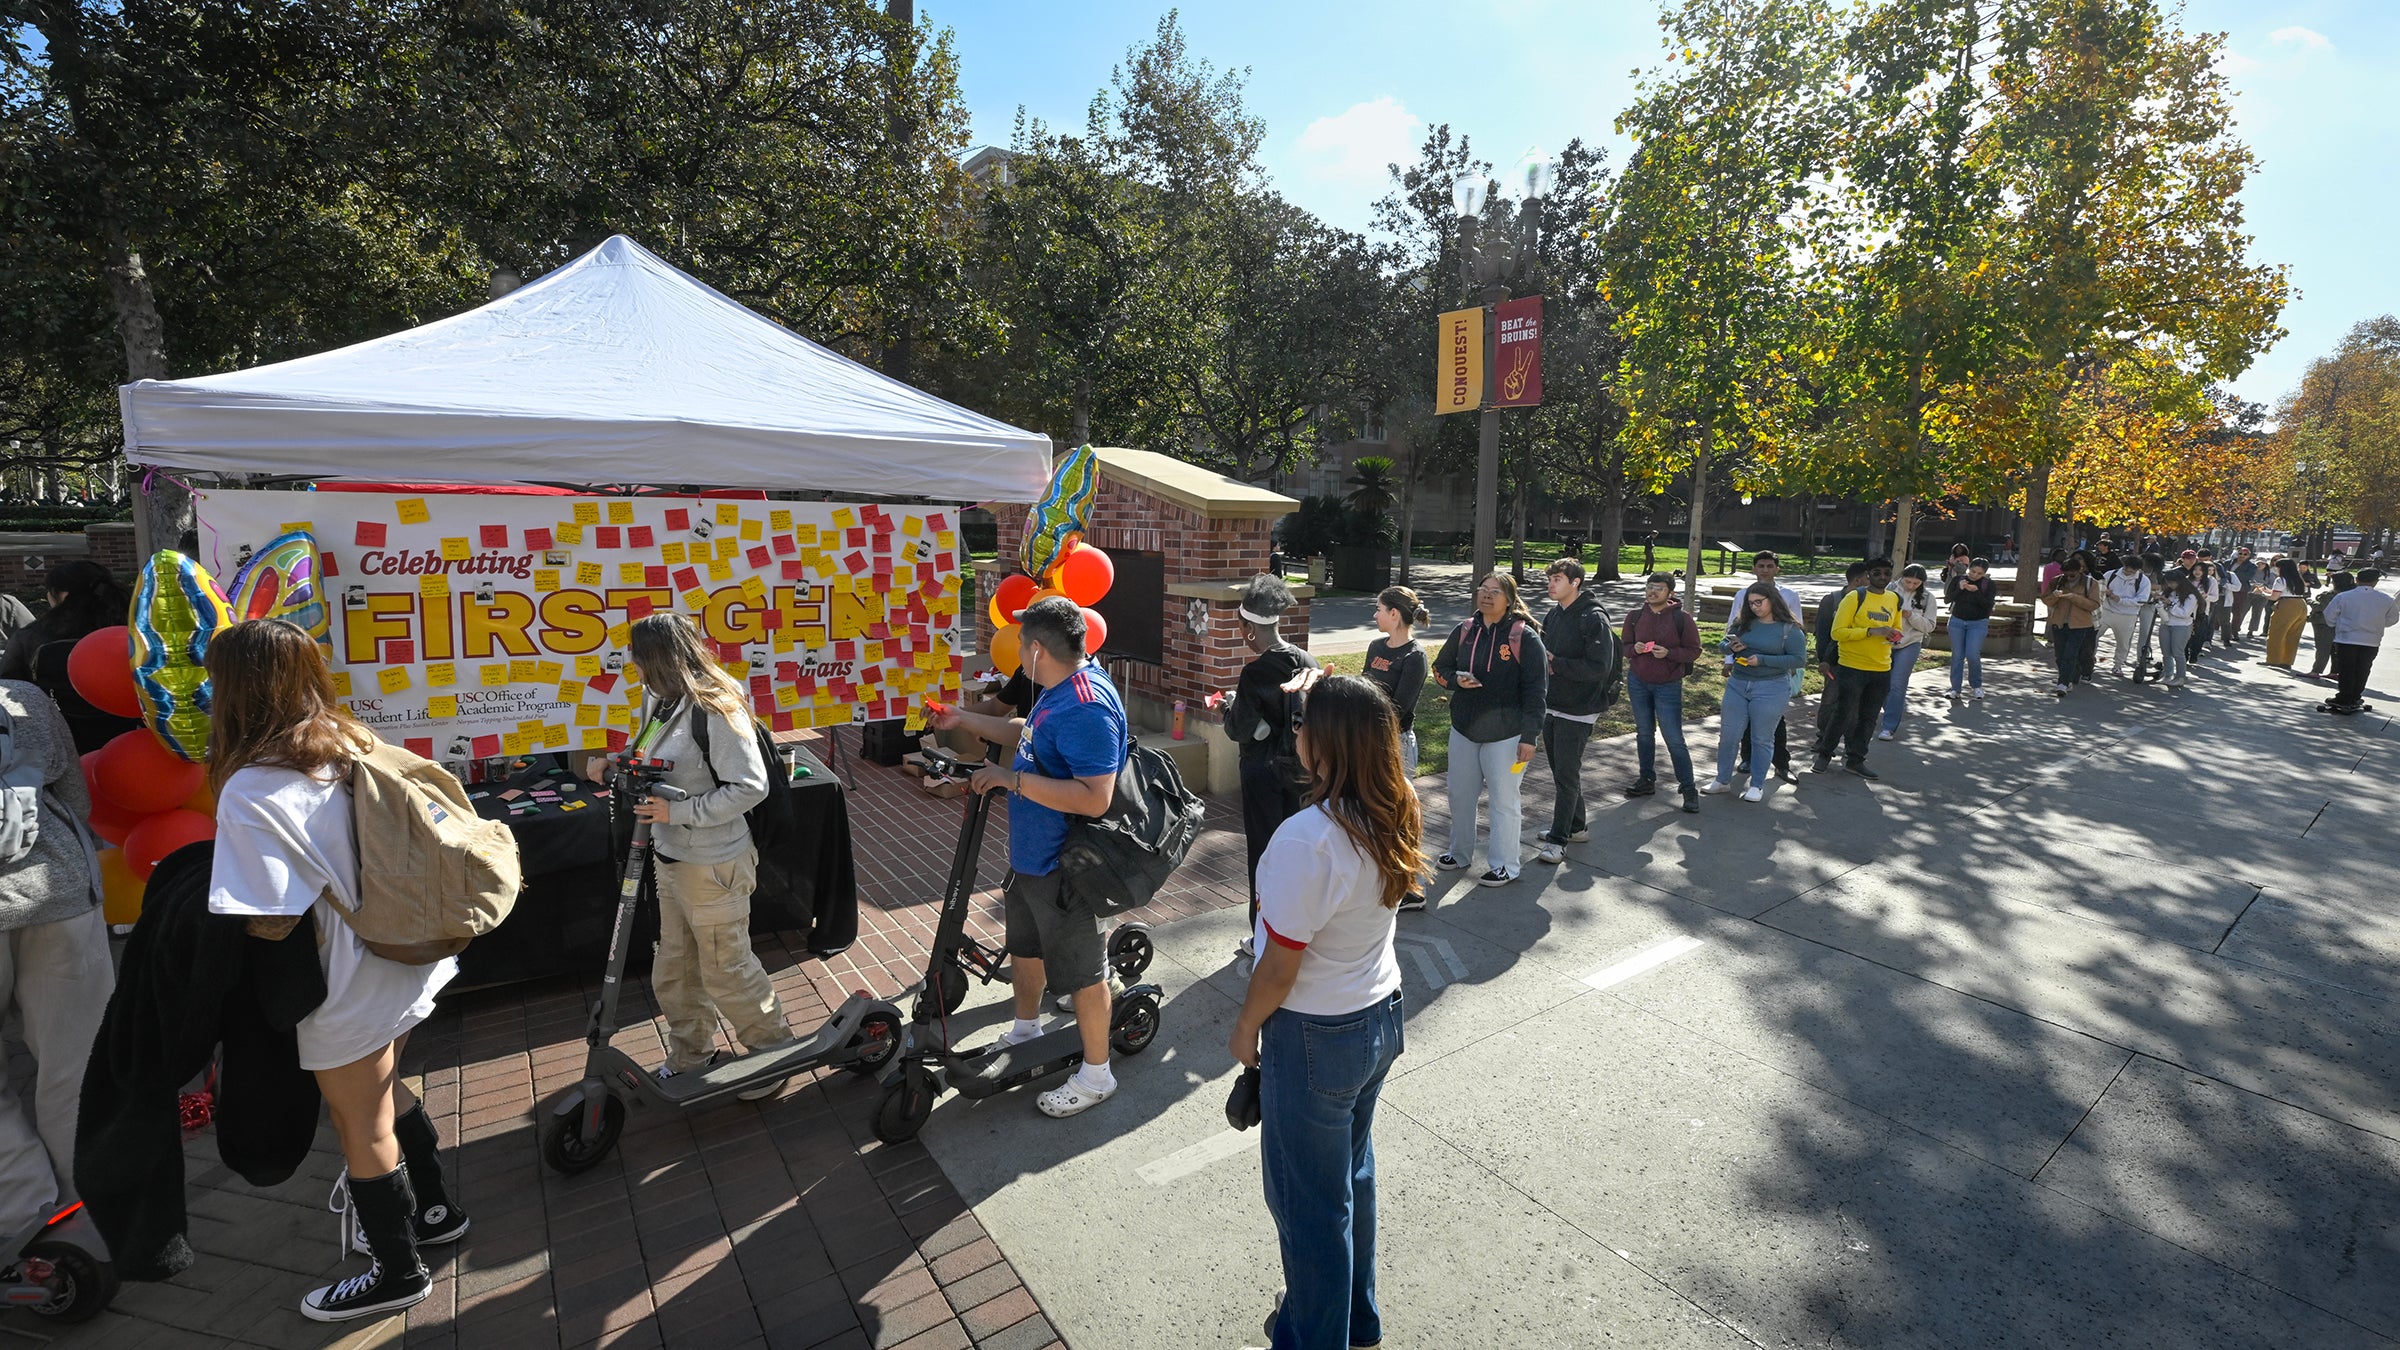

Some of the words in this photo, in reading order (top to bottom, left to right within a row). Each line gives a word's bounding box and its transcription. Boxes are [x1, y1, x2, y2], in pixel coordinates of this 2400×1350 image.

[1501, 317, 1524, 331] BEAT
[1525, 317, 1537, 328] the
[1501, 328, 1538, 344] BRUINS!
[1453, 319, 1467, 405] CONQUEST!
[360, 549, 535, 579] Celebrating
[455, 691, 485, 704] USC
[485, 689, 525, 702] Office
[525, 688, 538, 699] of
[349, 699, 383, 712] USC
[456, 702, 516, 716] Academic
[517, 700, 571, 713] Programs
[456, 718, 480, 726] Norman
[480, 717, 502, 726] Topping
[502, 715, 523, 723] Student
